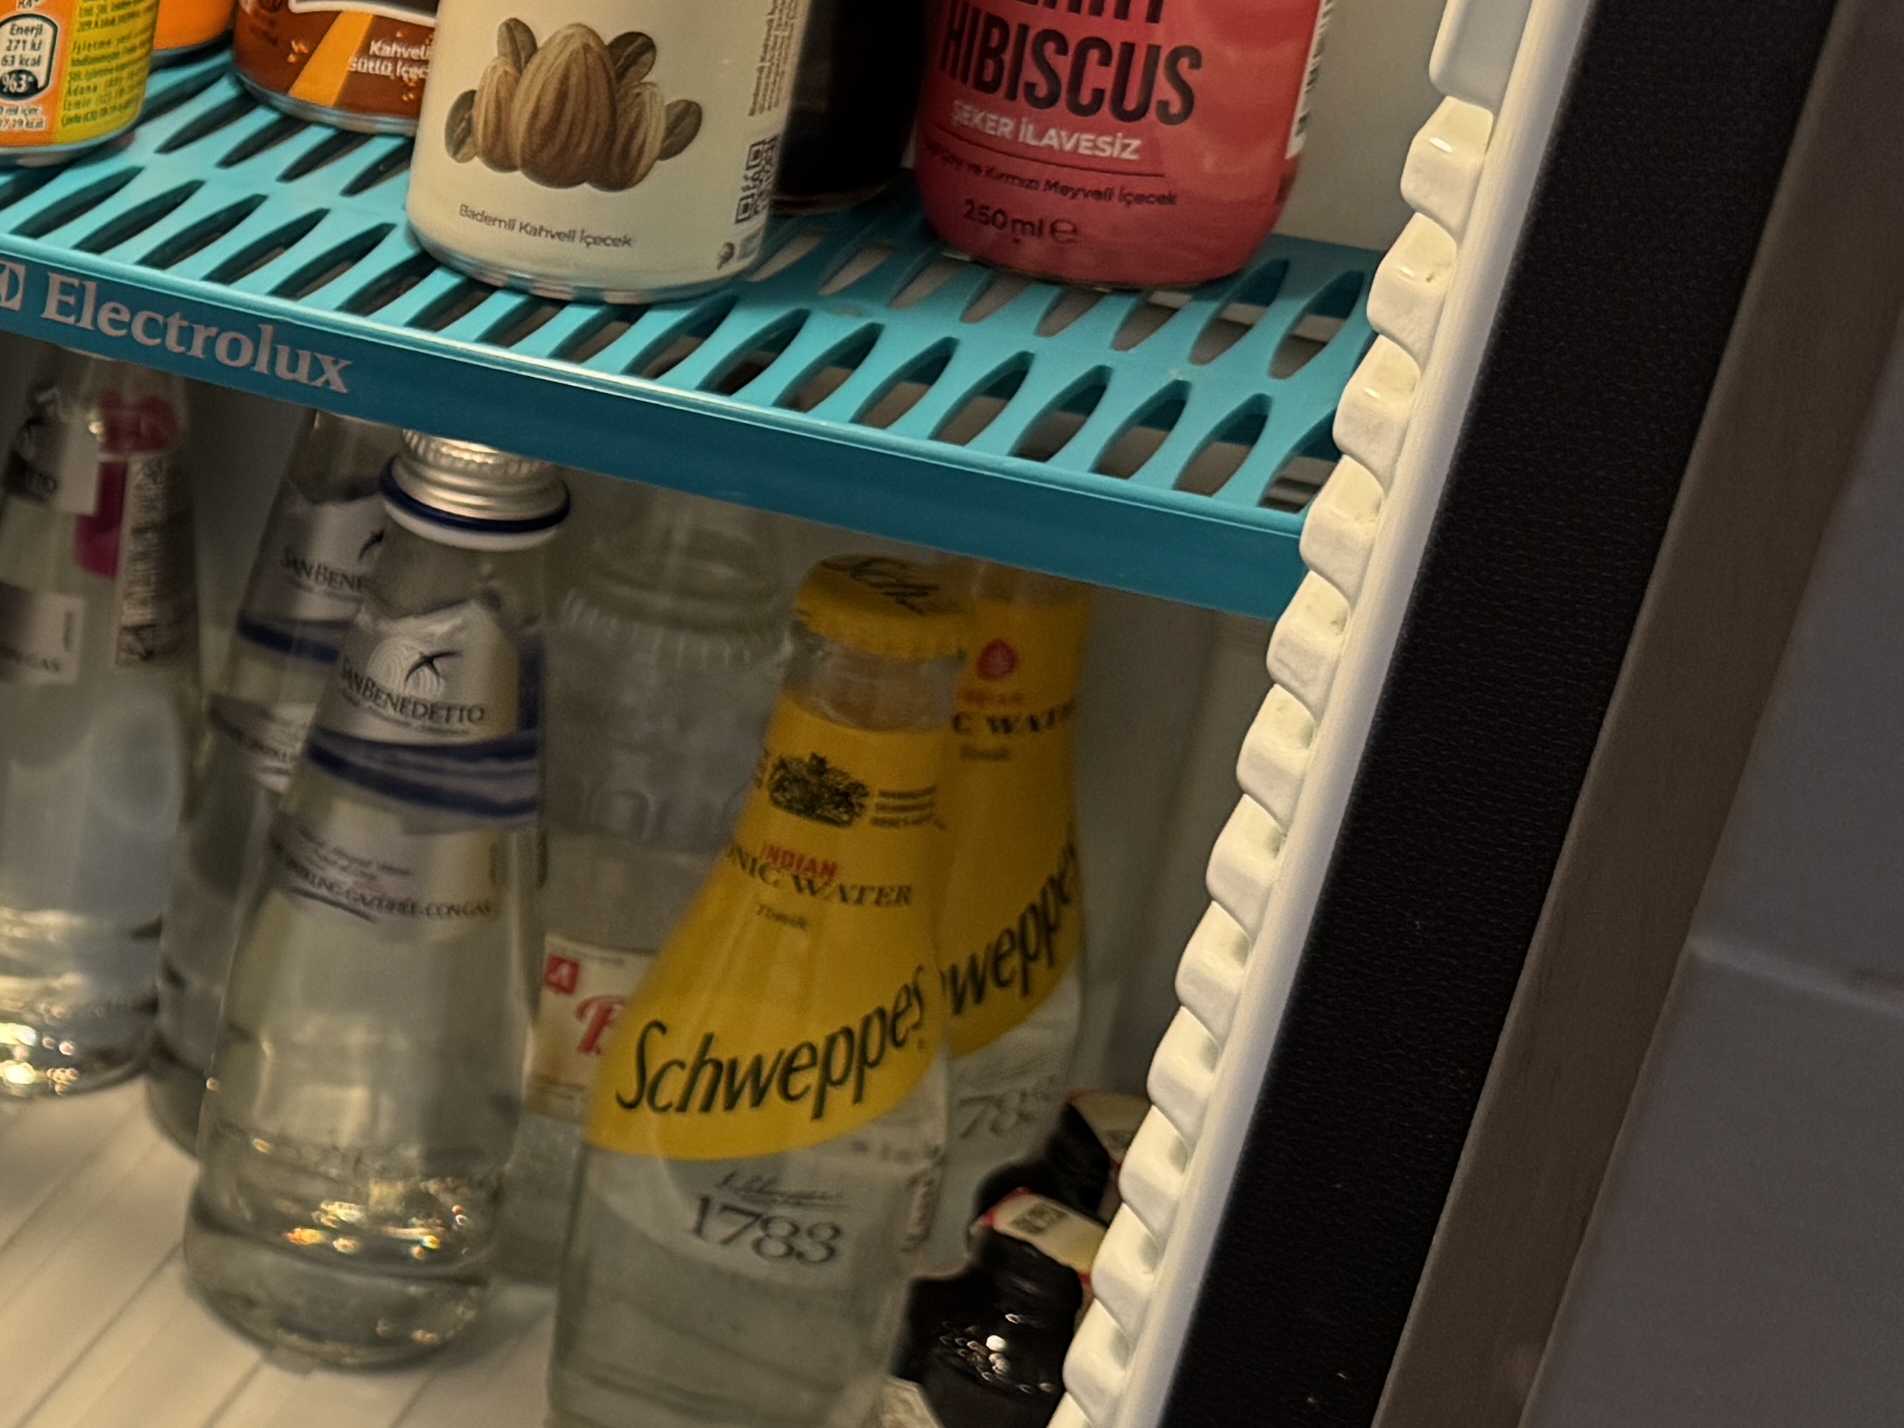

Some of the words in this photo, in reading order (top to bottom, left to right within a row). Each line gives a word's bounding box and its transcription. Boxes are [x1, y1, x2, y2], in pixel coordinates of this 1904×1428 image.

[1017, 115, 1143, 162] İLAVESİZ
[40, 270, 353, 395] Electrolux
[761, 840, 840, 881] INDIAN
[789, 875, 914, 909] WATER
[616, 963, 928, 1120] Schweppes
[692, 1194, 843, 1266] 1783
